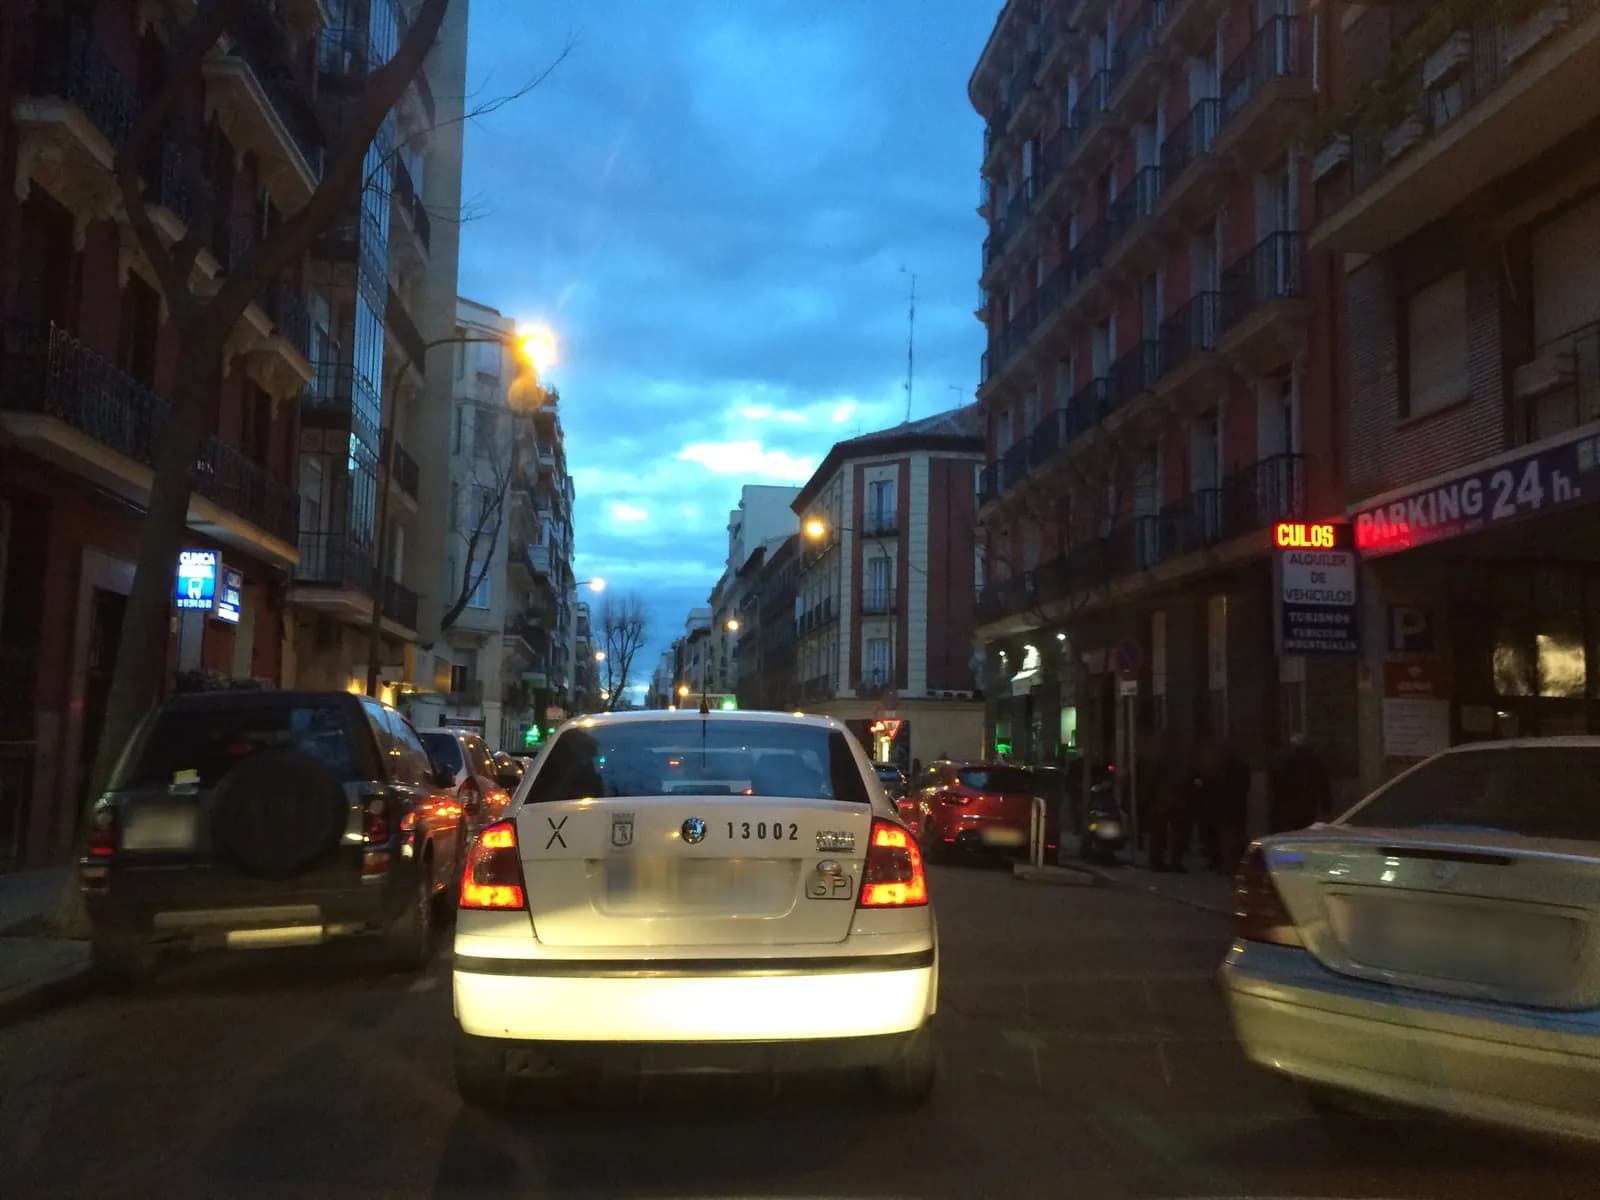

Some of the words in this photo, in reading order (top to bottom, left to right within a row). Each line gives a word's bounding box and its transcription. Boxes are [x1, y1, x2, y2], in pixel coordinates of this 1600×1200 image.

[1355, 477, 1484, 546] PARKING
[1489, 459, 1544, 521] 24
[1552, 469, 1581, 505] h.
[1276, 523, 1335, 548] CULOS
[1289, 552, 1347, 567] ALQUILER
[1310, 571, 1327, 584] DE
[1395, 607, 1426, 650] P
[727, 821, 799, 841] 13002
